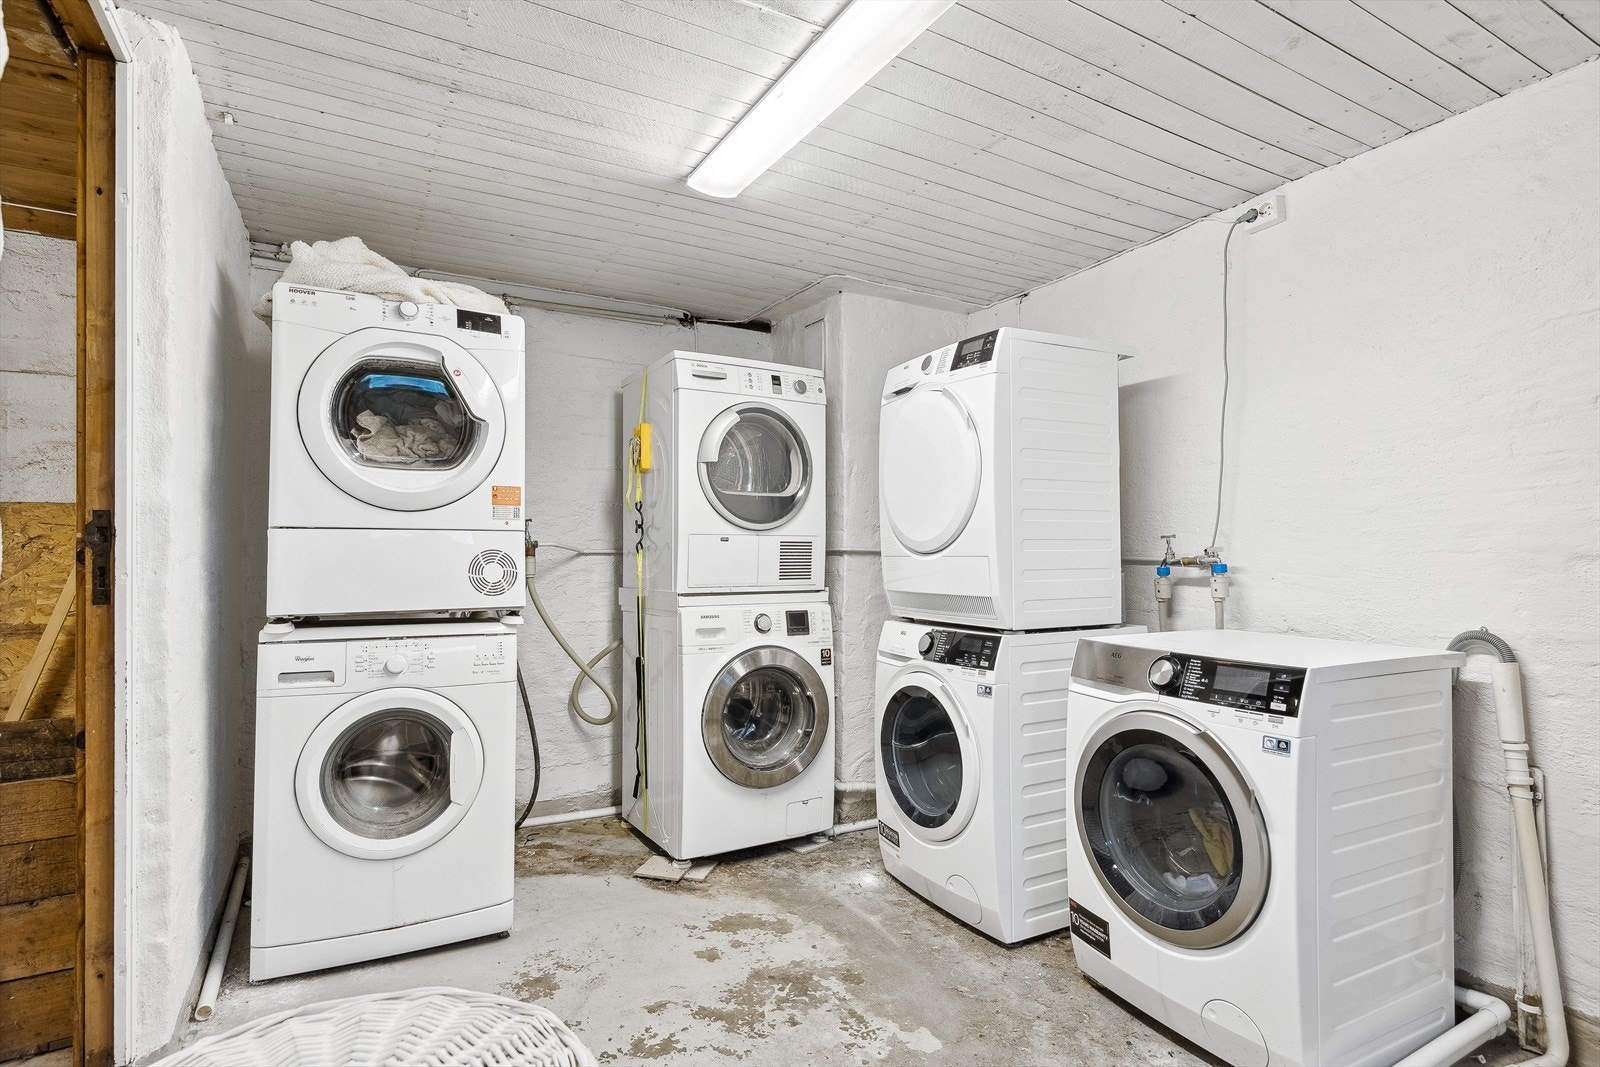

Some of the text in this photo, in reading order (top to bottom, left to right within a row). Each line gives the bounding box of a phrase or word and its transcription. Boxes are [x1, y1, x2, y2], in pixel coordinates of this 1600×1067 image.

[288, 288, 316, 296] HOOVER
[821, 649, 830, 658] 10
[294, 655, 315, 663] Whirlpool
[1070, 911, 1080, 926] 10
